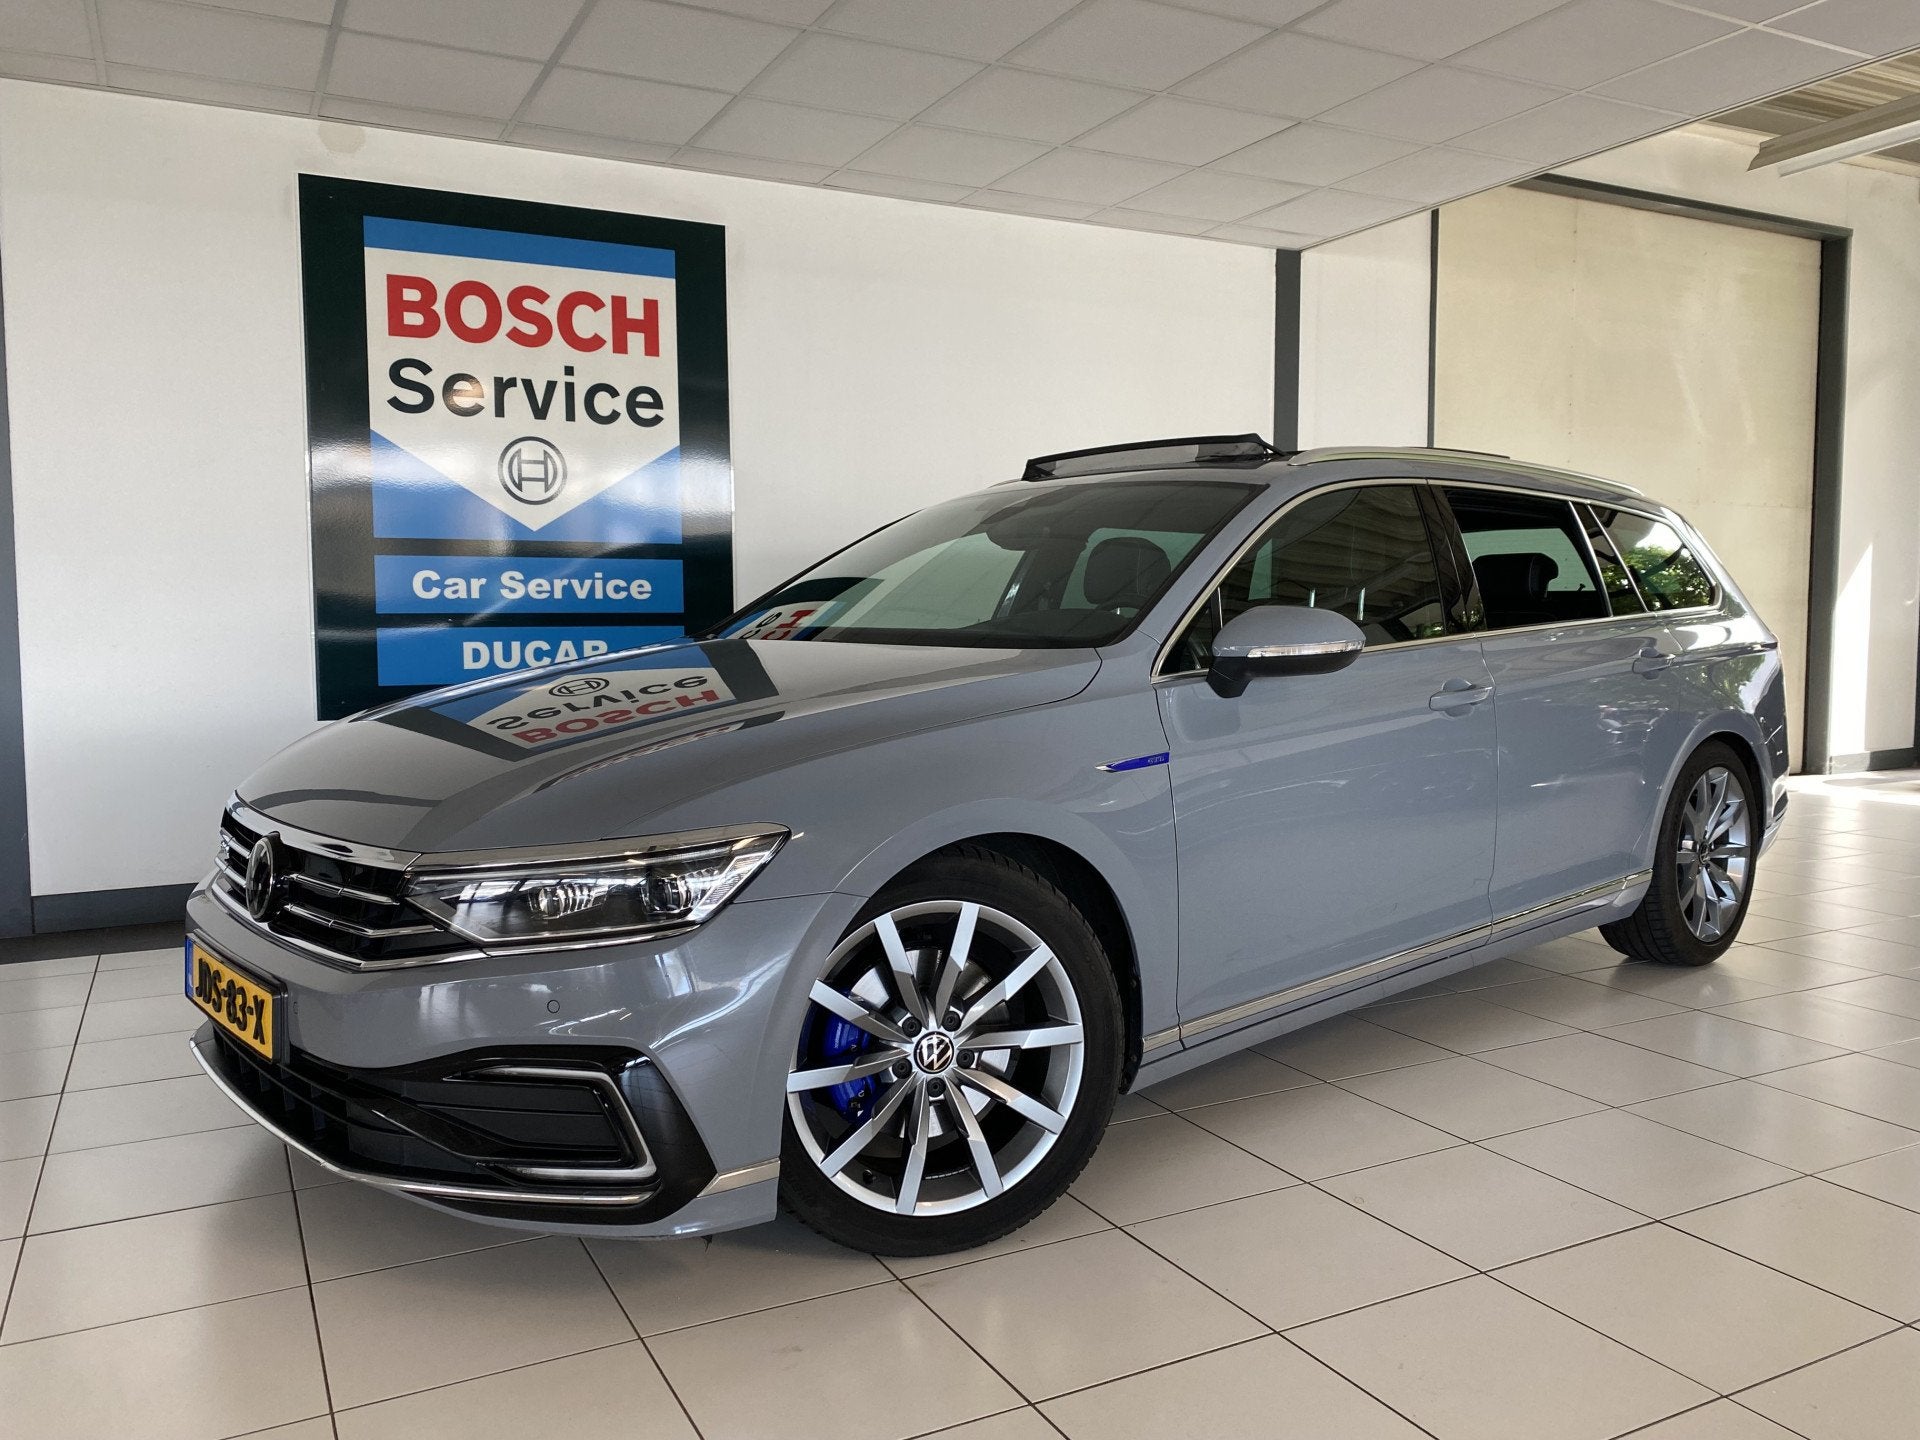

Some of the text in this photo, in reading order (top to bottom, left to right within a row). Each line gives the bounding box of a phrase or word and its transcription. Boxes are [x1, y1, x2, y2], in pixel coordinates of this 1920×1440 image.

[387, 274, 660, 357] BOSCH
[387, 358, 665, 428] Service
[412, 569, 652, 603] Car Service
[195, 957, 266, 1045] JDS-83-X
